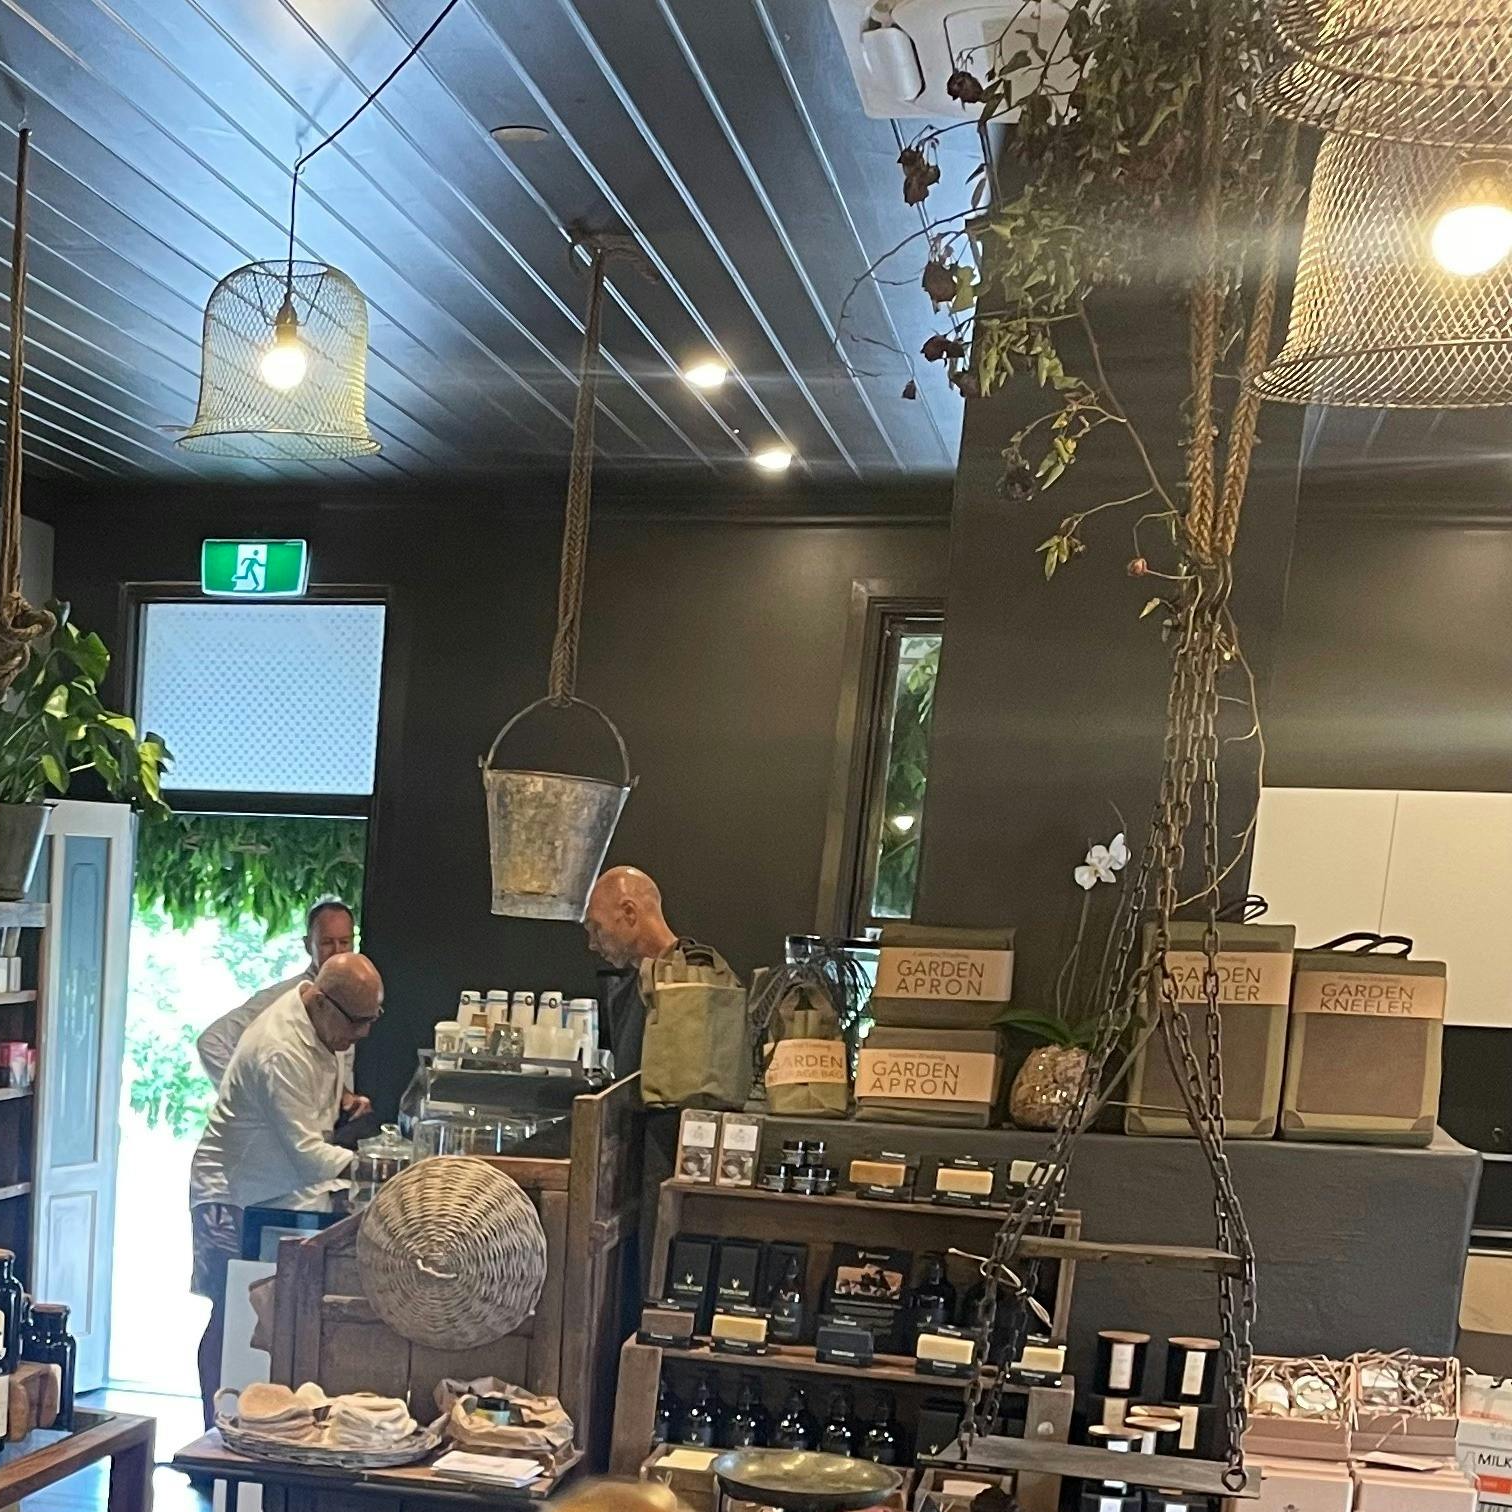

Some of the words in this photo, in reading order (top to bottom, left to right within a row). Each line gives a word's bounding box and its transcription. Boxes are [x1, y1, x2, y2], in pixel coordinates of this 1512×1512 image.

[897, 959, 984, 979] GARDEN
[895, 978, 983, 996] APRON
[1321, 983, 1416, 1000] GARDEN
[1320, 997, 1413, 1014] KNEELER
[872, 1060, 960, 1079] GARDEN
[869, 1077, 958, 1096] APRON
